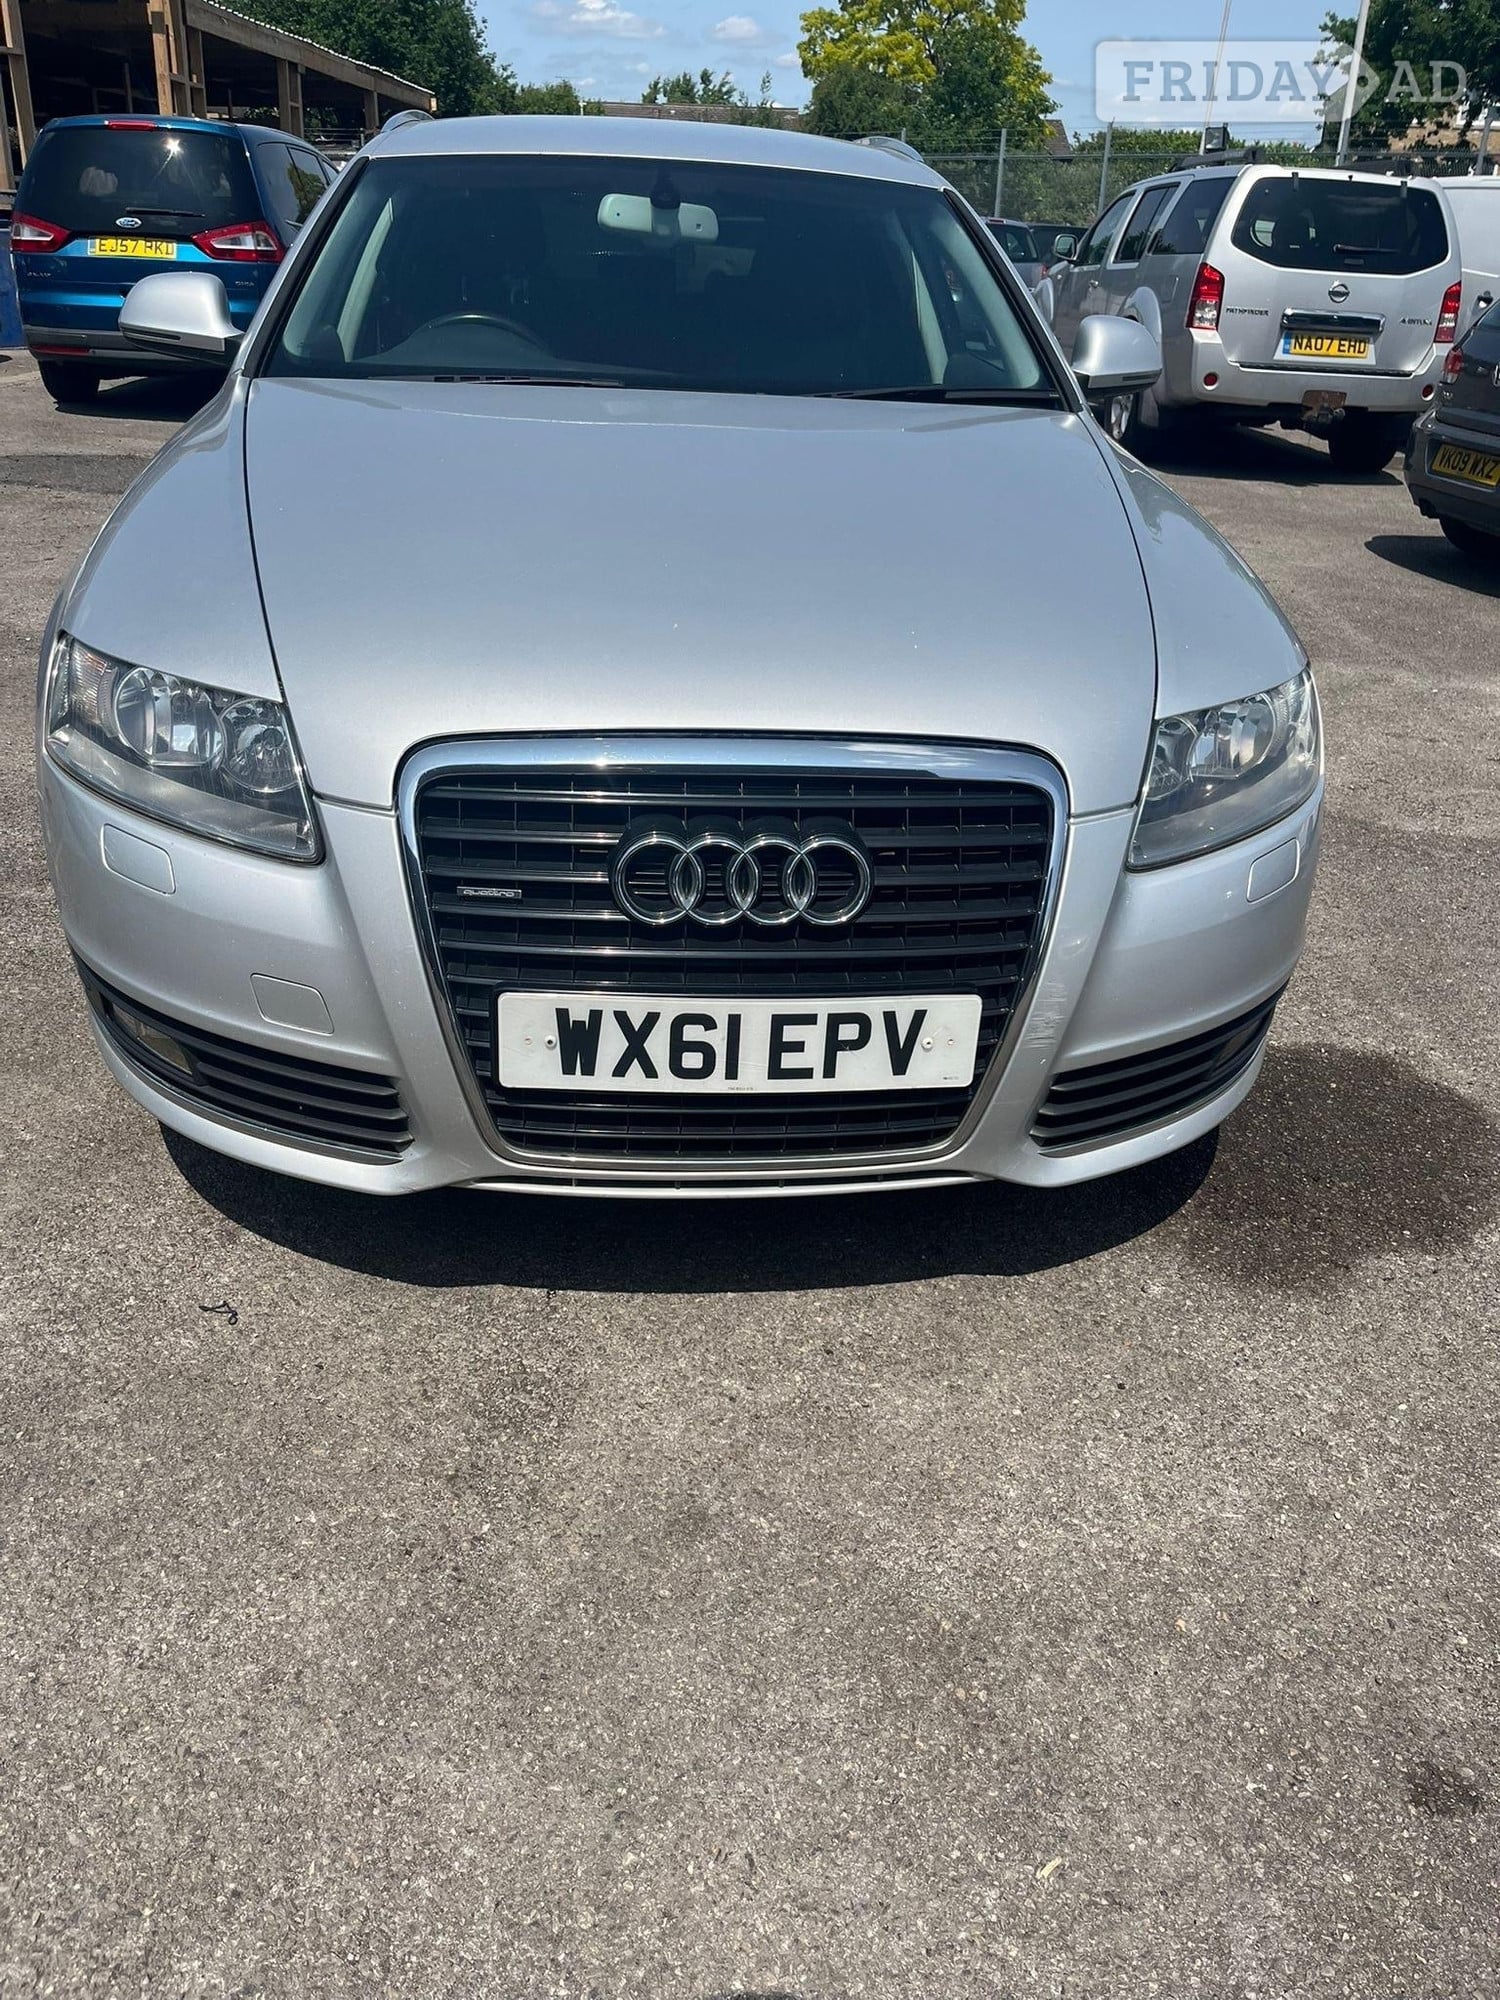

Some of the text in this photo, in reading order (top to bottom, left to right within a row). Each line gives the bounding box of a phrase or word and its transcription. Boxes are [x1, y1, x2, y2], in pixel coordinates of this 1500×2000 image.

[98, 237, 139, 254] EJ57
[1293, 335, 1368, 355] NA07 EHD
[1438, 446, 1499, 481] VK09 WXZ
[463, 889, 515, 898] quattro
[555, 1007, 929, 1081] WX61 EPV
